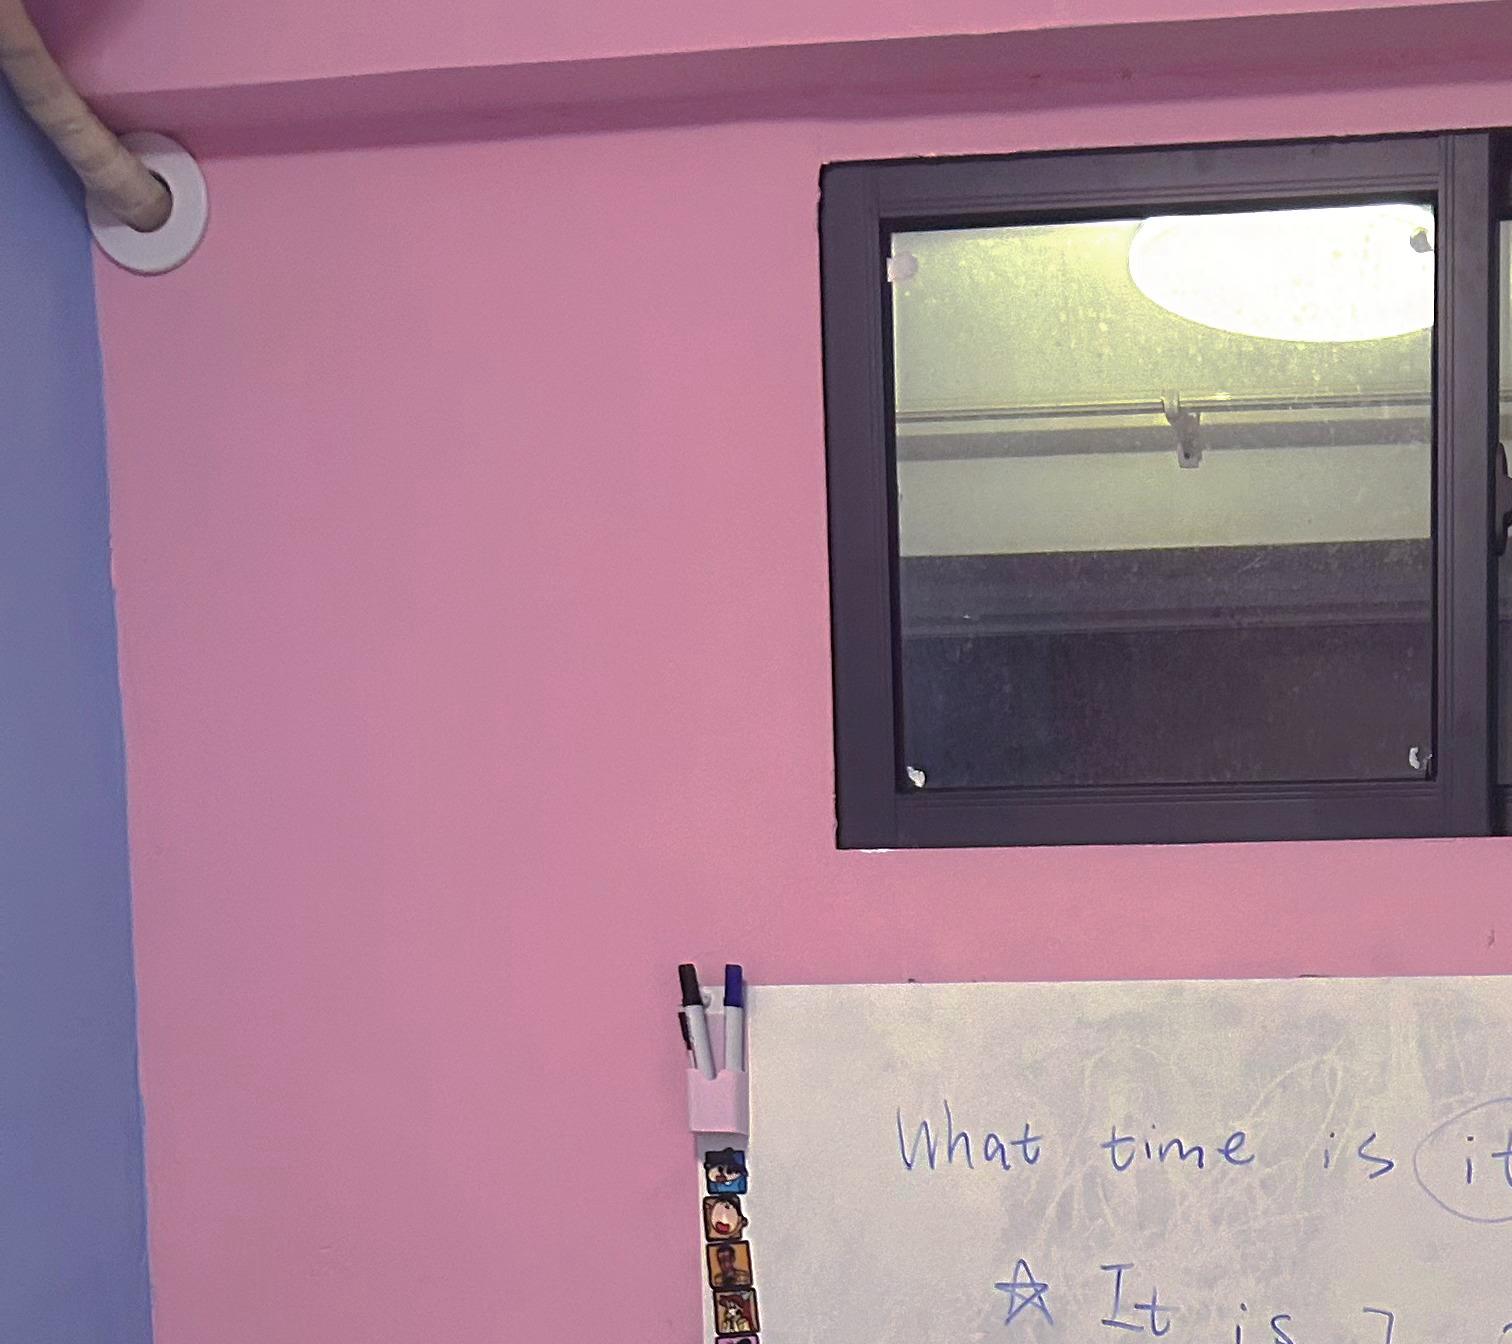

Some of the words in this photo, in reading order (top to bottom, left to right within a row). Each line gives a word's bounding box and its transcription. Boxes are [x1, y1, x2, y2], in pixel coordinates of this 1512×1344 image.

[896, 1099, 1043, 1170] What
[1100, 1124, 1256, 1171] time
[1323, 1132, 1395, 1180] is
[1100, 1262, 1178, 1337] It
